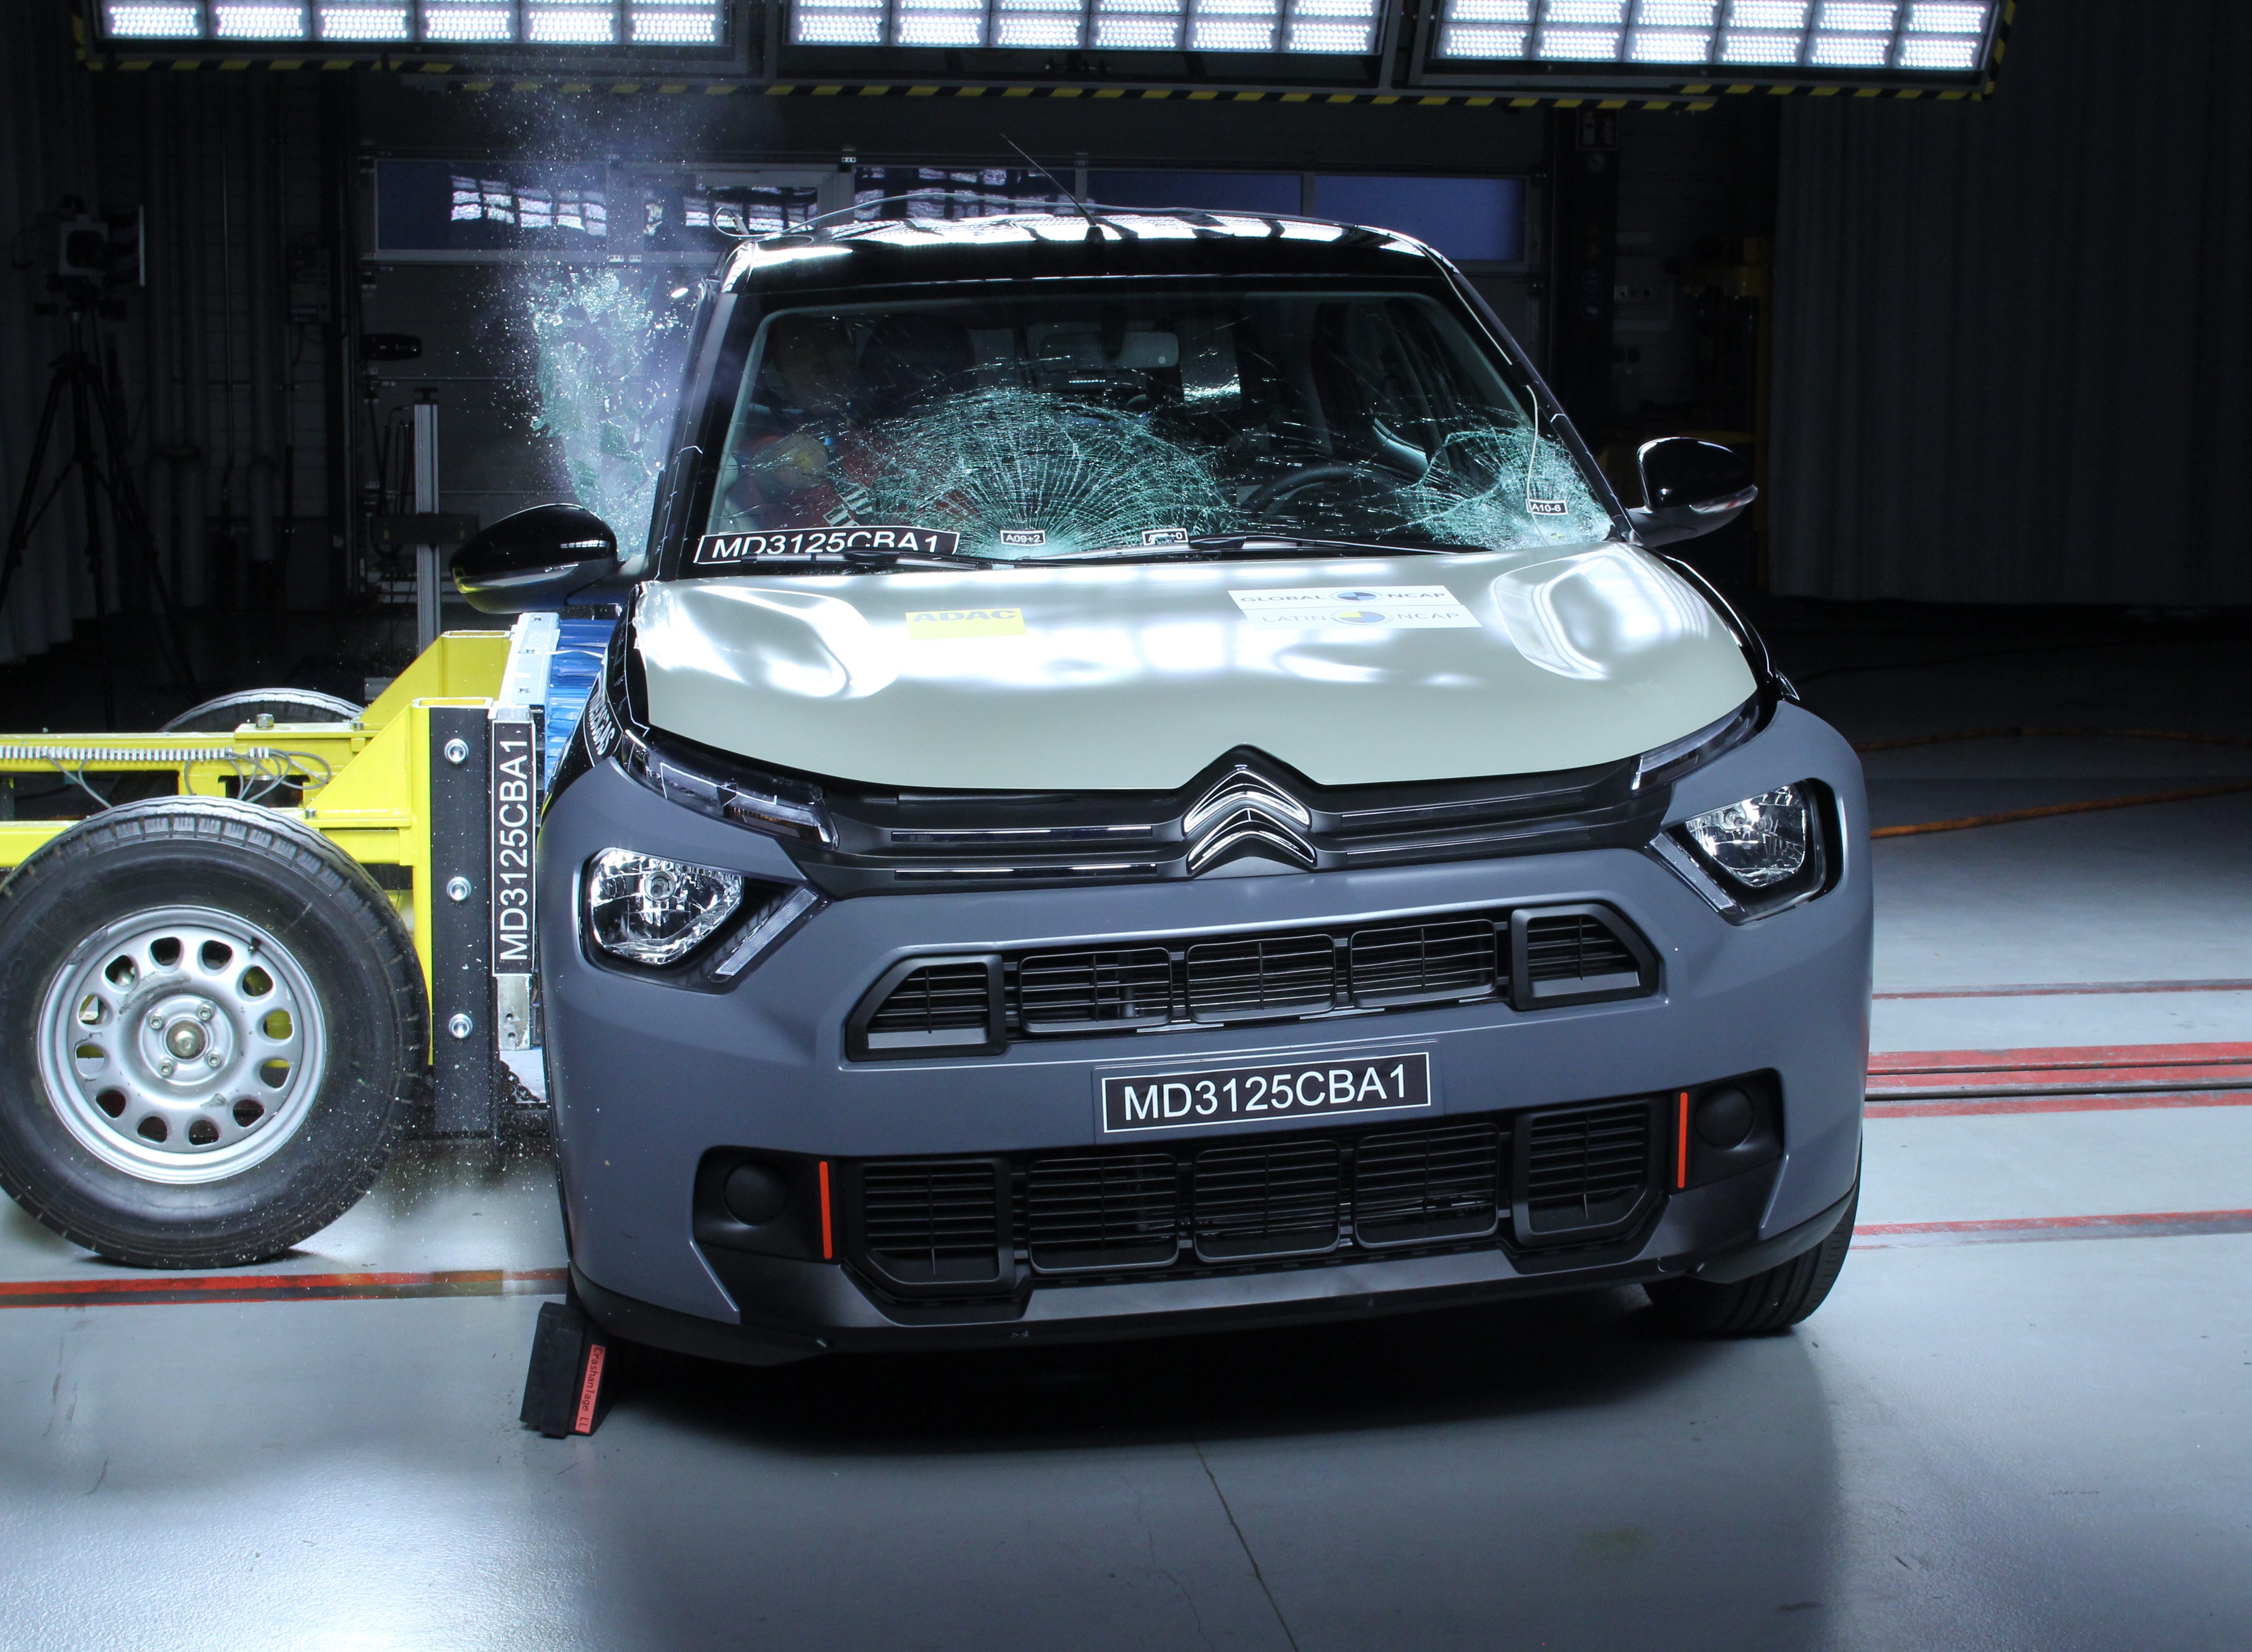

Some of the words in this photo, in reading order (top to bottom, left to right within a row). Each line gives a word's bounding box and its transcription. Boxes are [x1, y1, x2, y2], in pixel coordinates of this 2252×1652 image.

[1532, 504, 1562, 512] A10-6
[712, 531, 938, 559] MD3125CBA1
[913, 610, 1017, 622] ADAC
[498, 741, 528, 960] MD3125CBA1
[1125, 1064, 1405, 1121] MD3125CBA1
[582, 1347, 603, 1411] Crashanlage
[579, 1417, 589, 1427] LL
